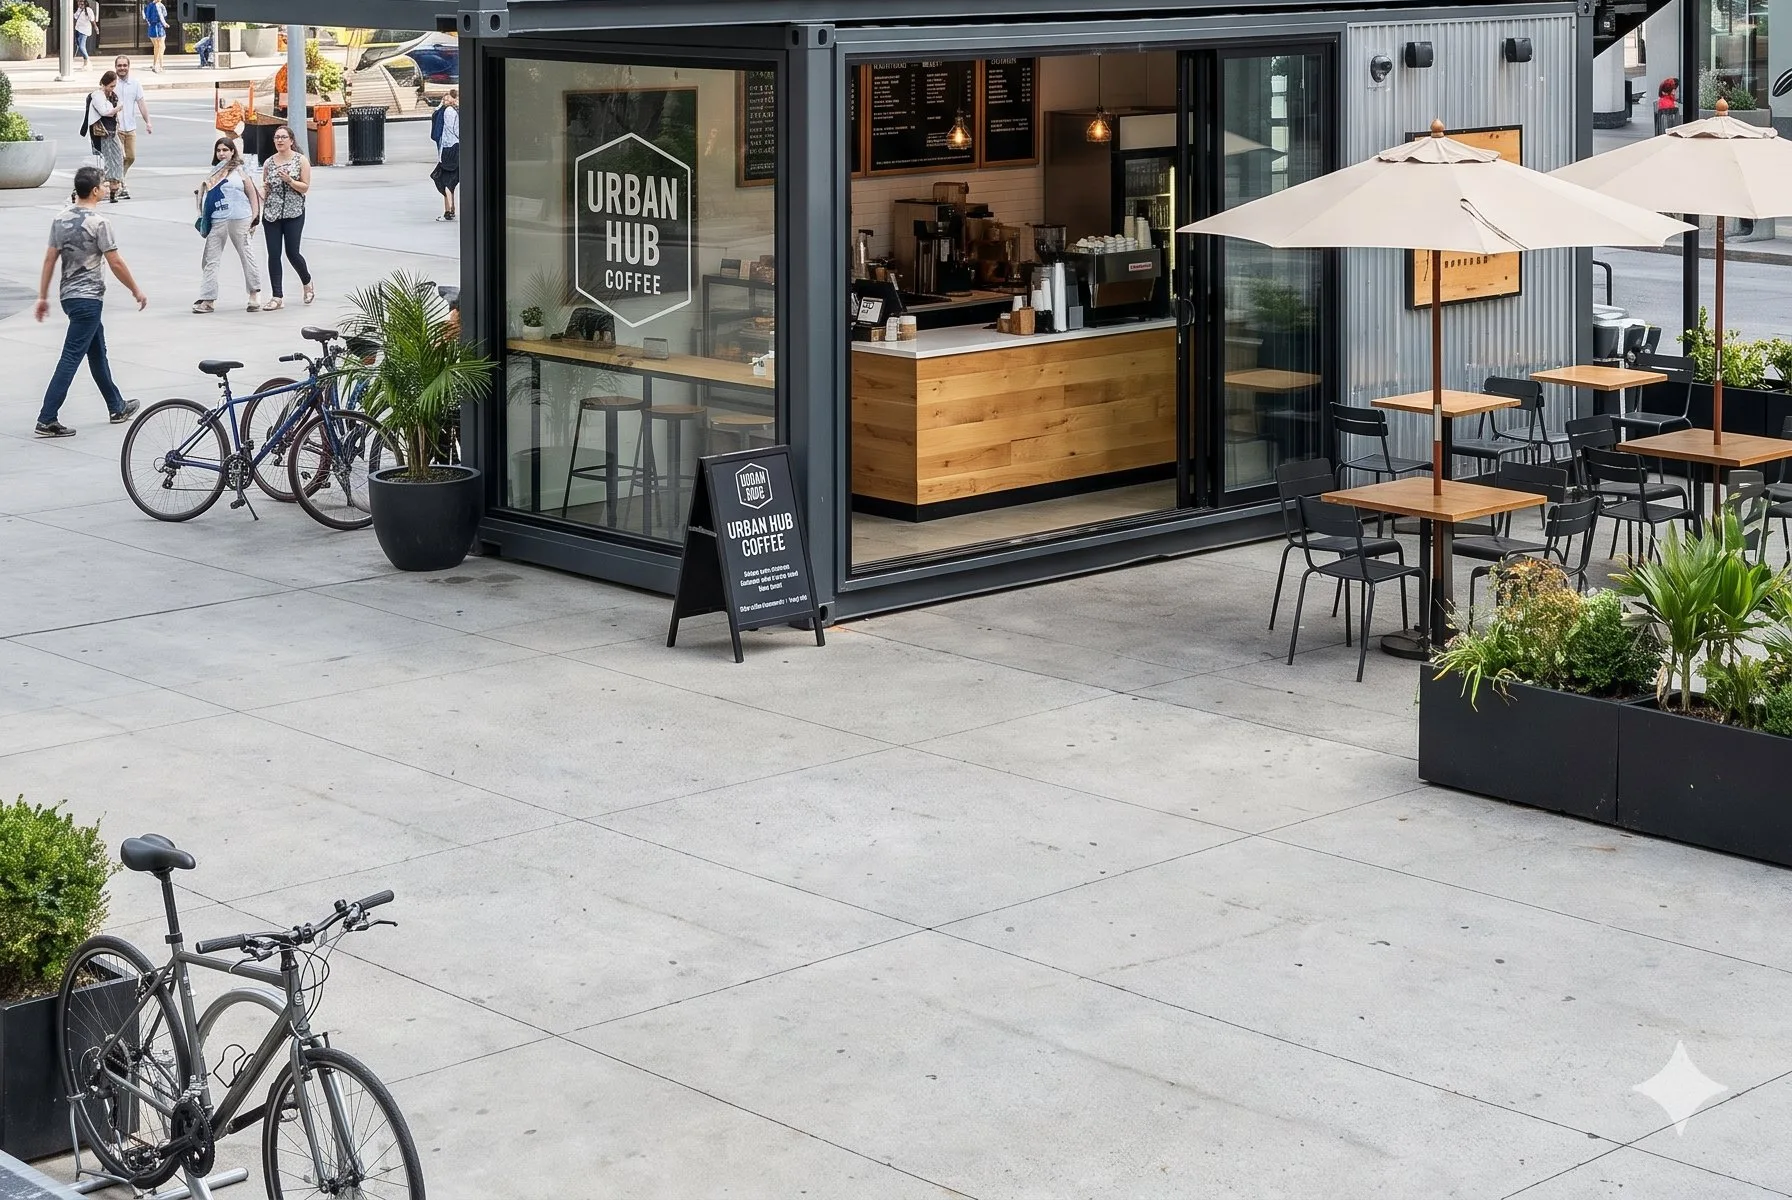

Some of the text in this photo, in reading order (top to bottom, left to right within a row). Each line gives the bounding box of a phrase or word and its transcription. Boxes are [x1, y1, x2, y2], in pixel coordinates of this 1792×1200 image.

[587, 170, 678, 220] URBAN
[606, 220, 660, 267] HUB
[605, 269, 661, 295] COFFEE
[727, 512, 794, 539] URBAN HUB
[741, 533, 786, 557] COFFEE
